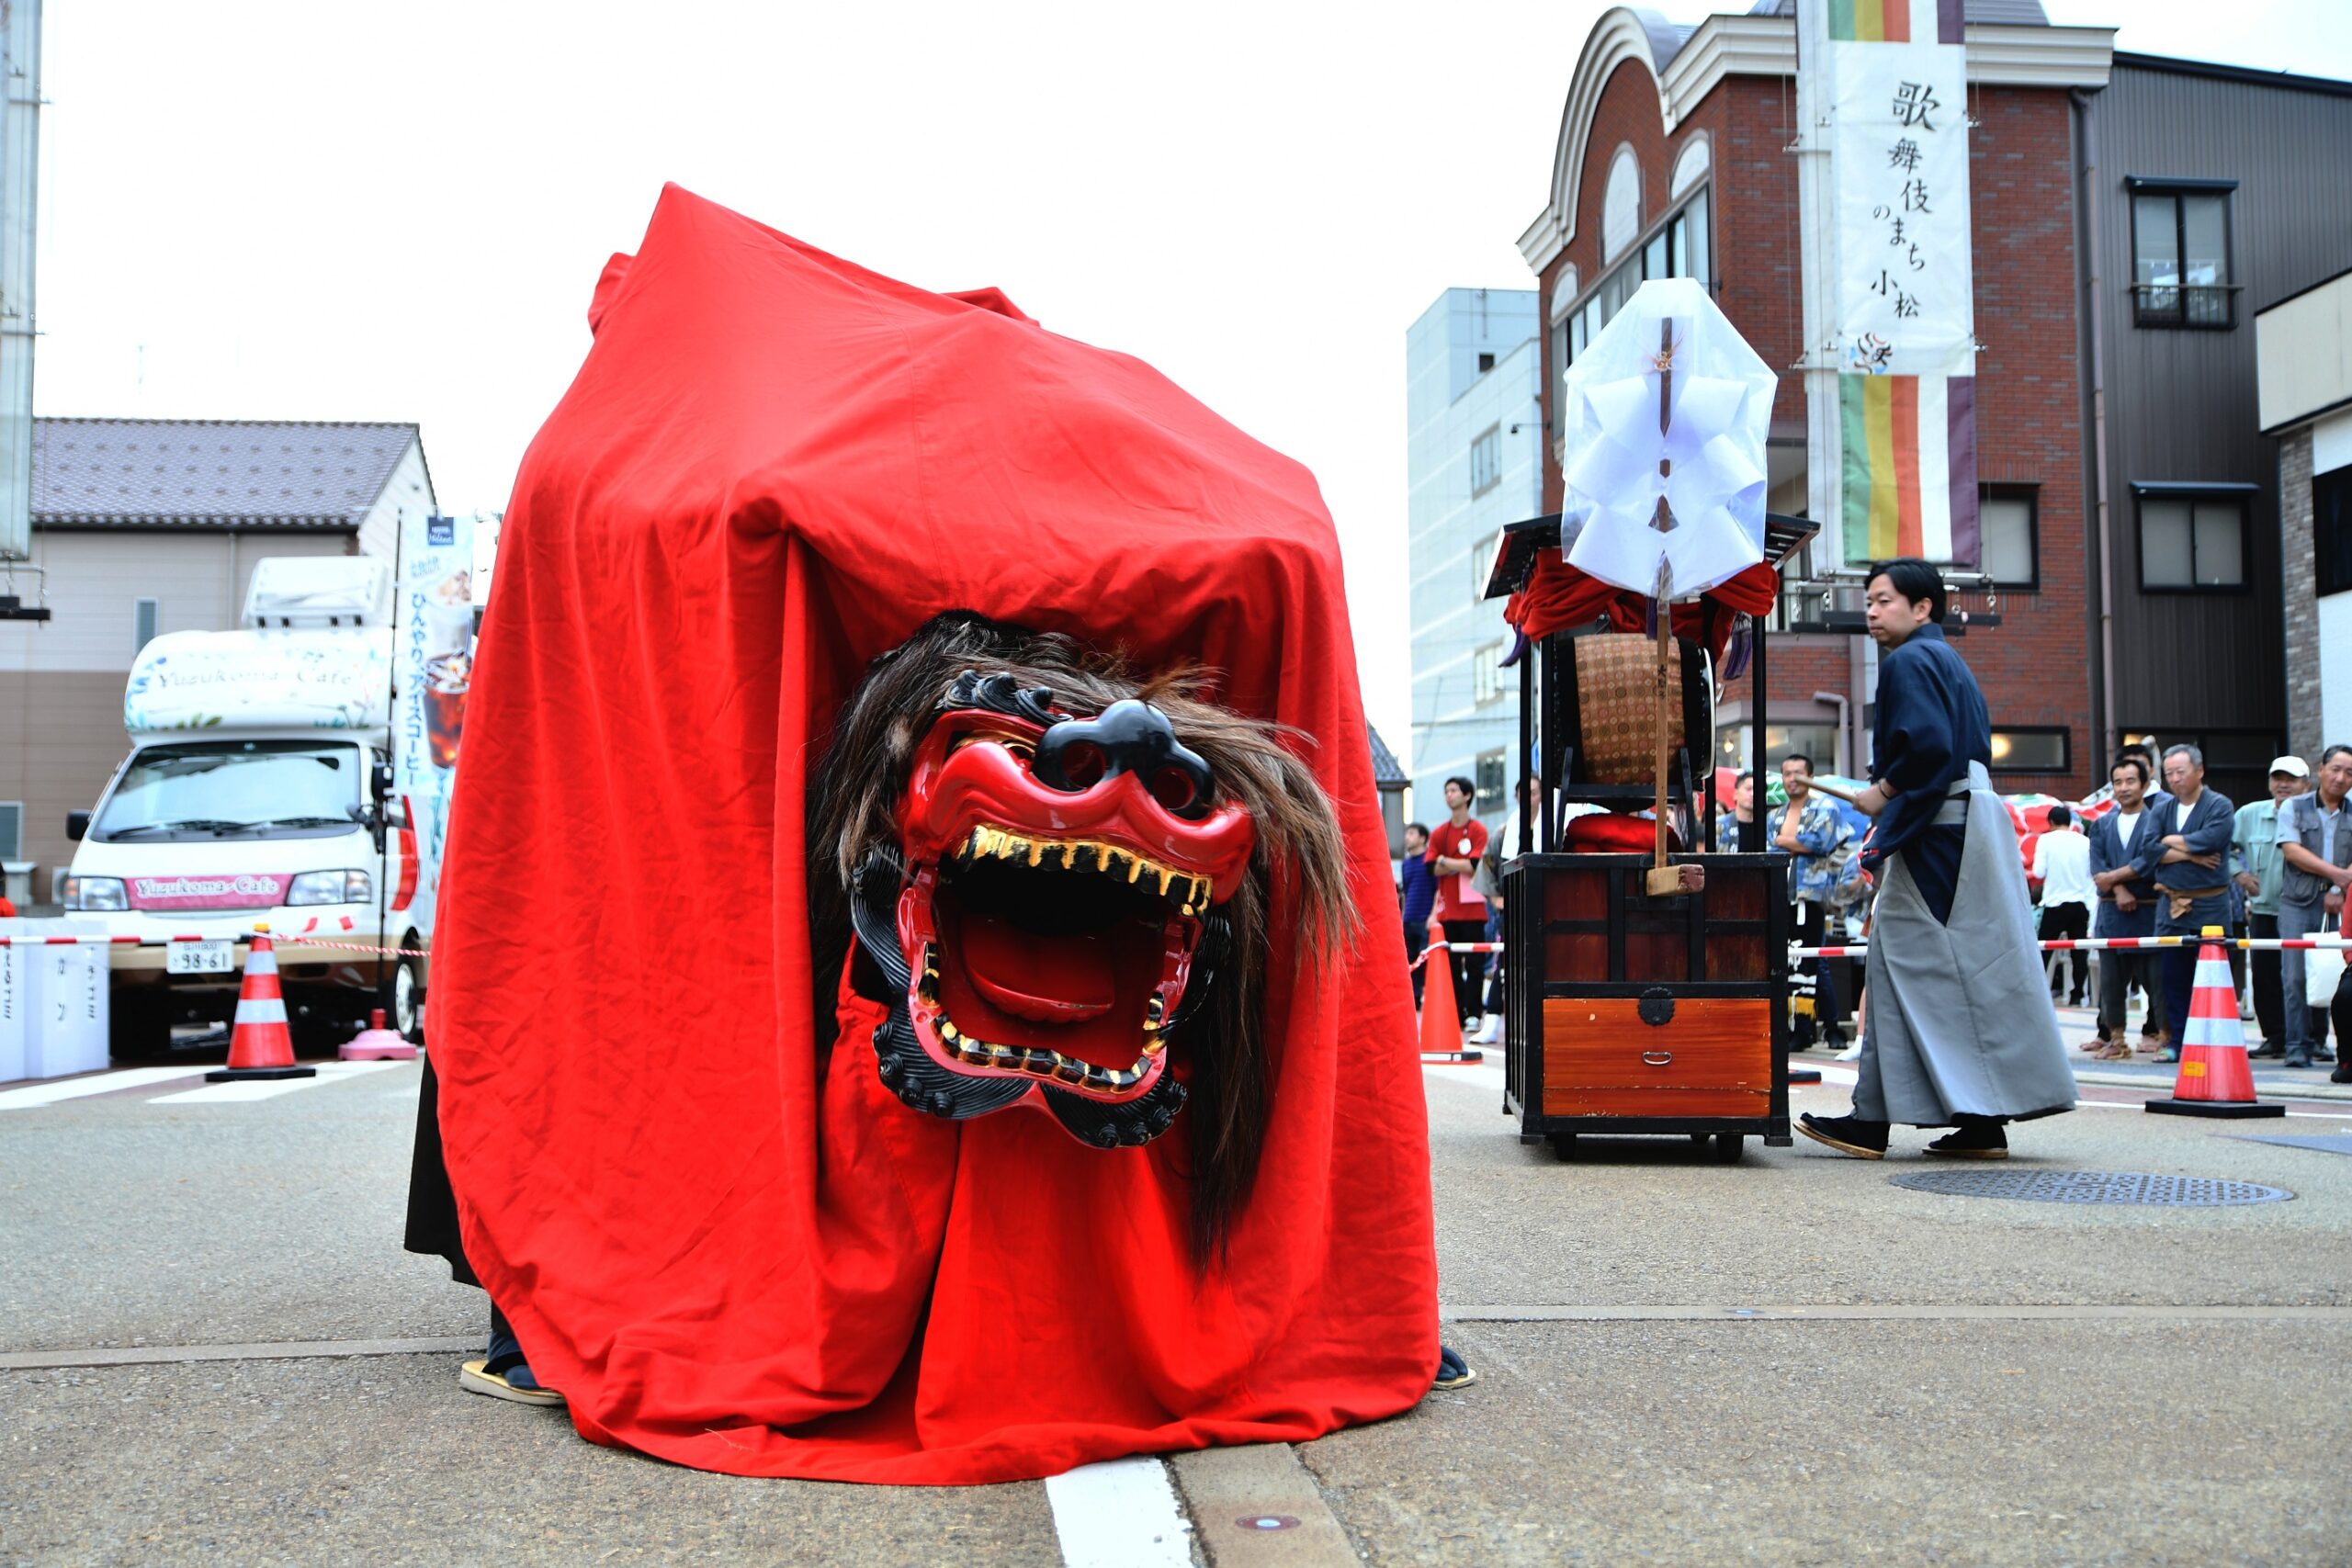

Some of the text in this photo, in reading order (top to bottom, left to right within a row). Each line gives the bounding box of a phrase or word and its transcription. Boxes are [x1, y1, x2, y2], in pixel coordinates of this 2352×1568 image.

[1871, 81, 1941, 320] 歌舞伎のまち小松
